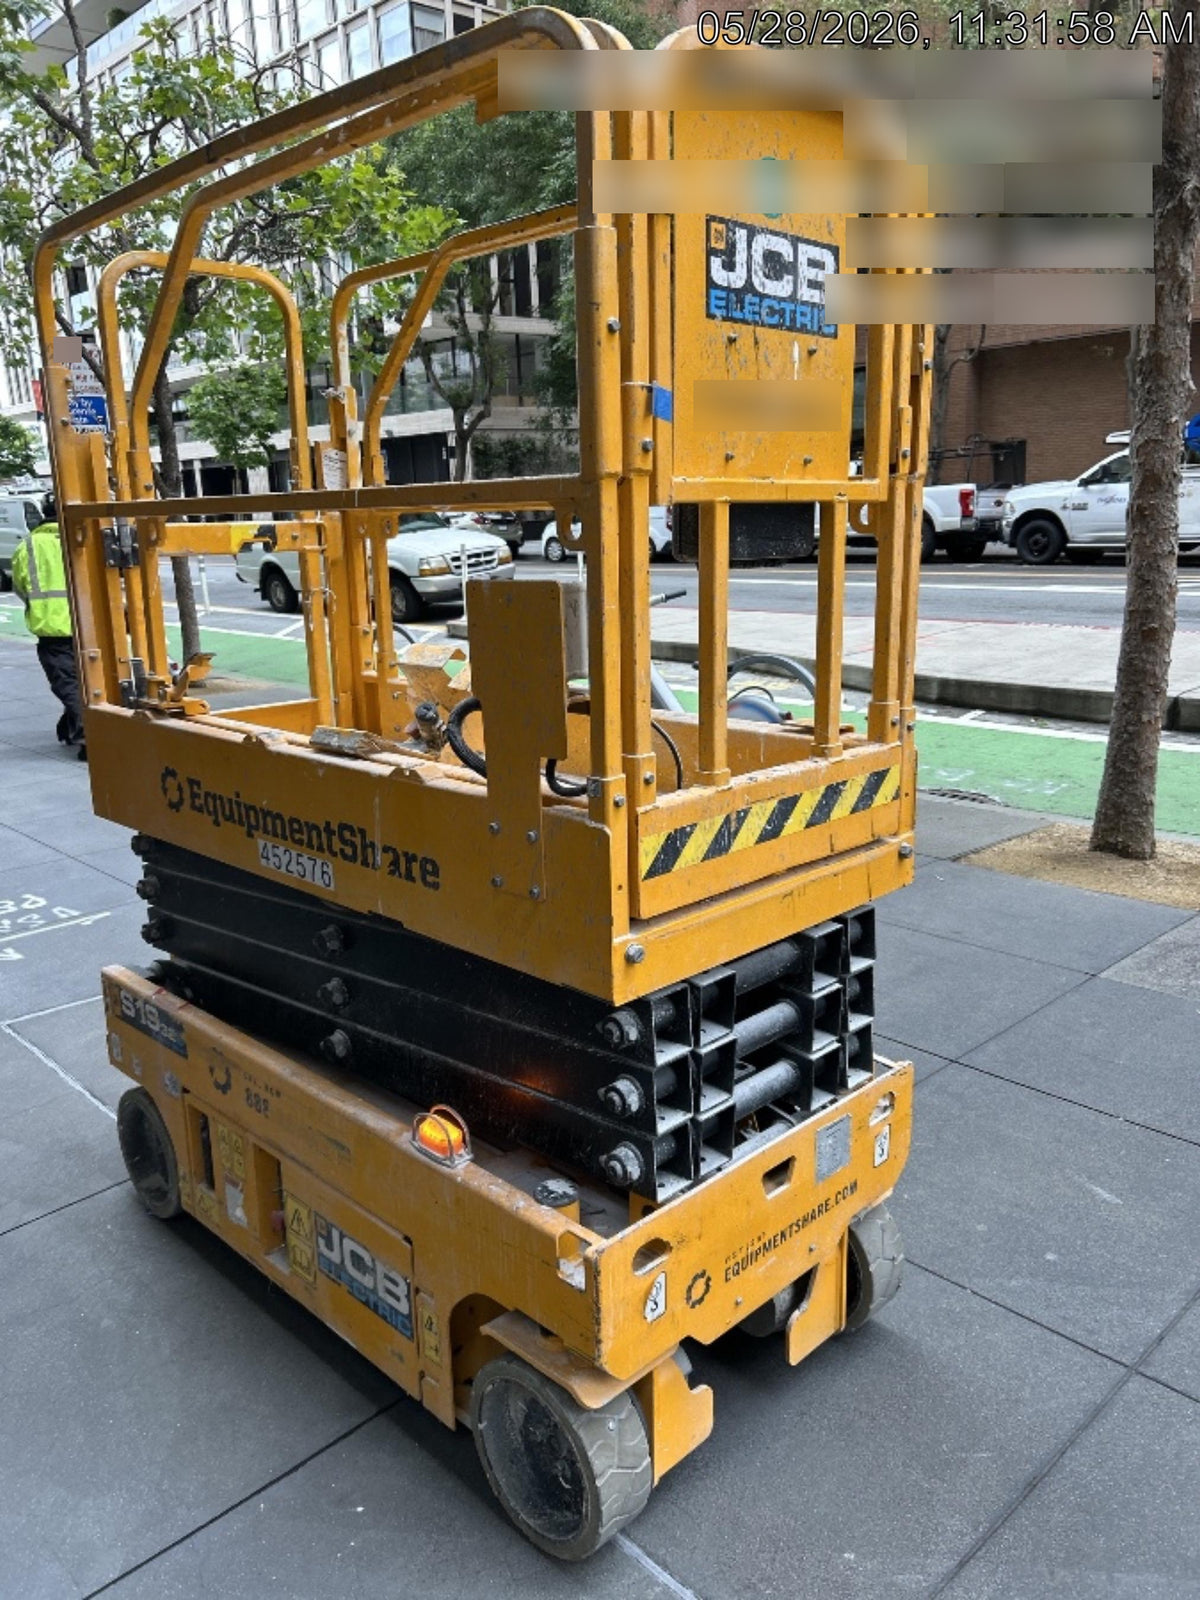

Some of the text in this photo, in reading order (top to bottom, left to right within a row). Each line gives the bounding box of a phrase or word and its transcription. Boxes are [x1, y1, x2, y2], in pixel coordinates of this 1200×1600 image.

[709, 226, 836, 305] JCB
[186, 777, 441, 891] EquipmentShare
[260, 842, 332, 888] 452576
[317, 1226, 410, 1315] JCB
[724, 1178, 858, 1284] EQUIPMENTSHARE.COM
